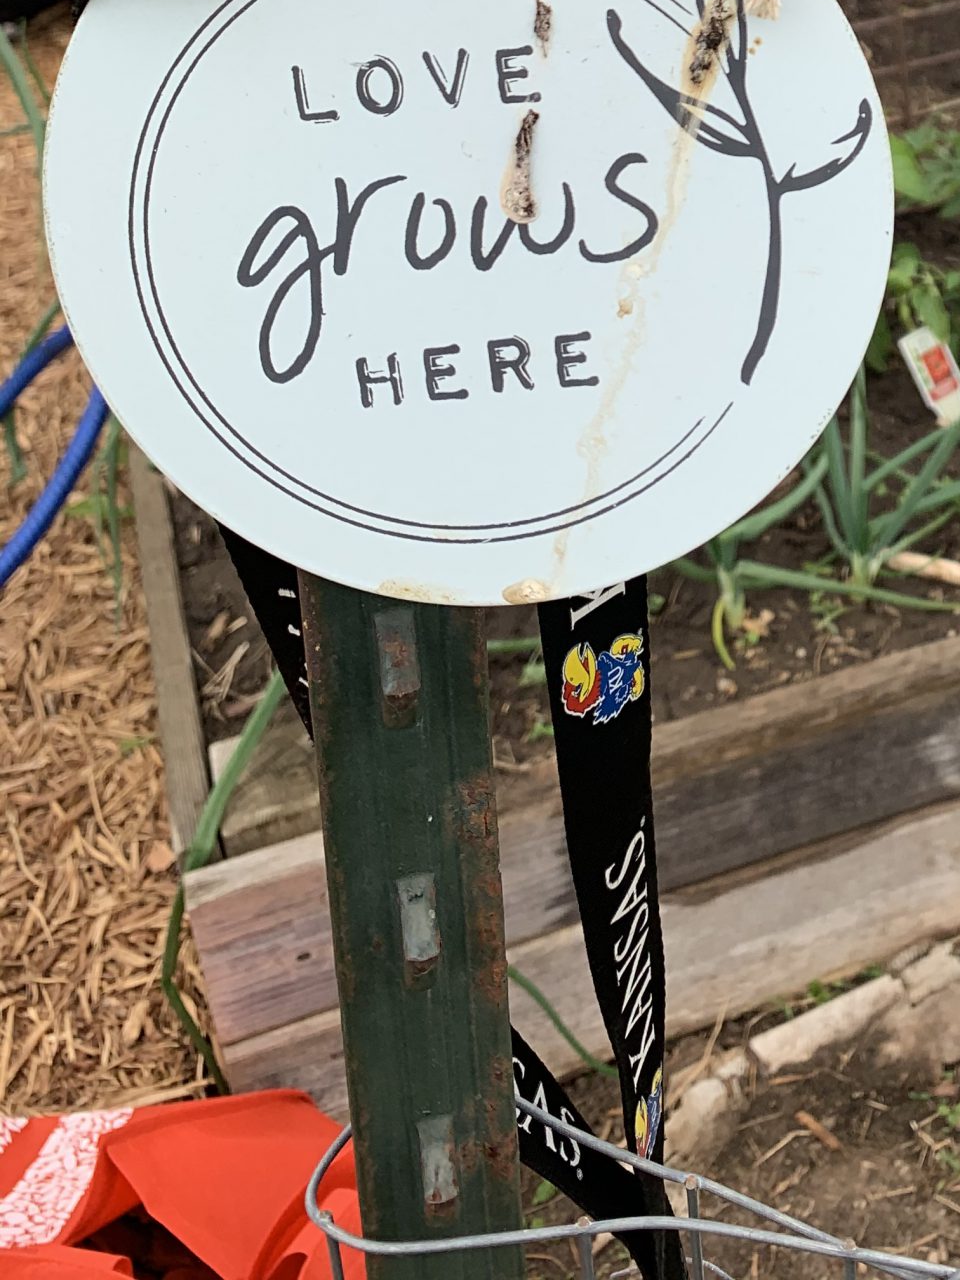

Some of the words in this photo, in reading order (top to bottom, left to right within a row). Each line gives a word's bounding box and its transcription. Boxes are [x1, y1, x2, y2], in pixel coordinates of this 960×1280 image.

[291, 44, 542, 124] LOVE
[236, 152, 659, 385] grows
[355, 330, 601, 410] HERE
[604, 829, 657, 1095] KANSAS
